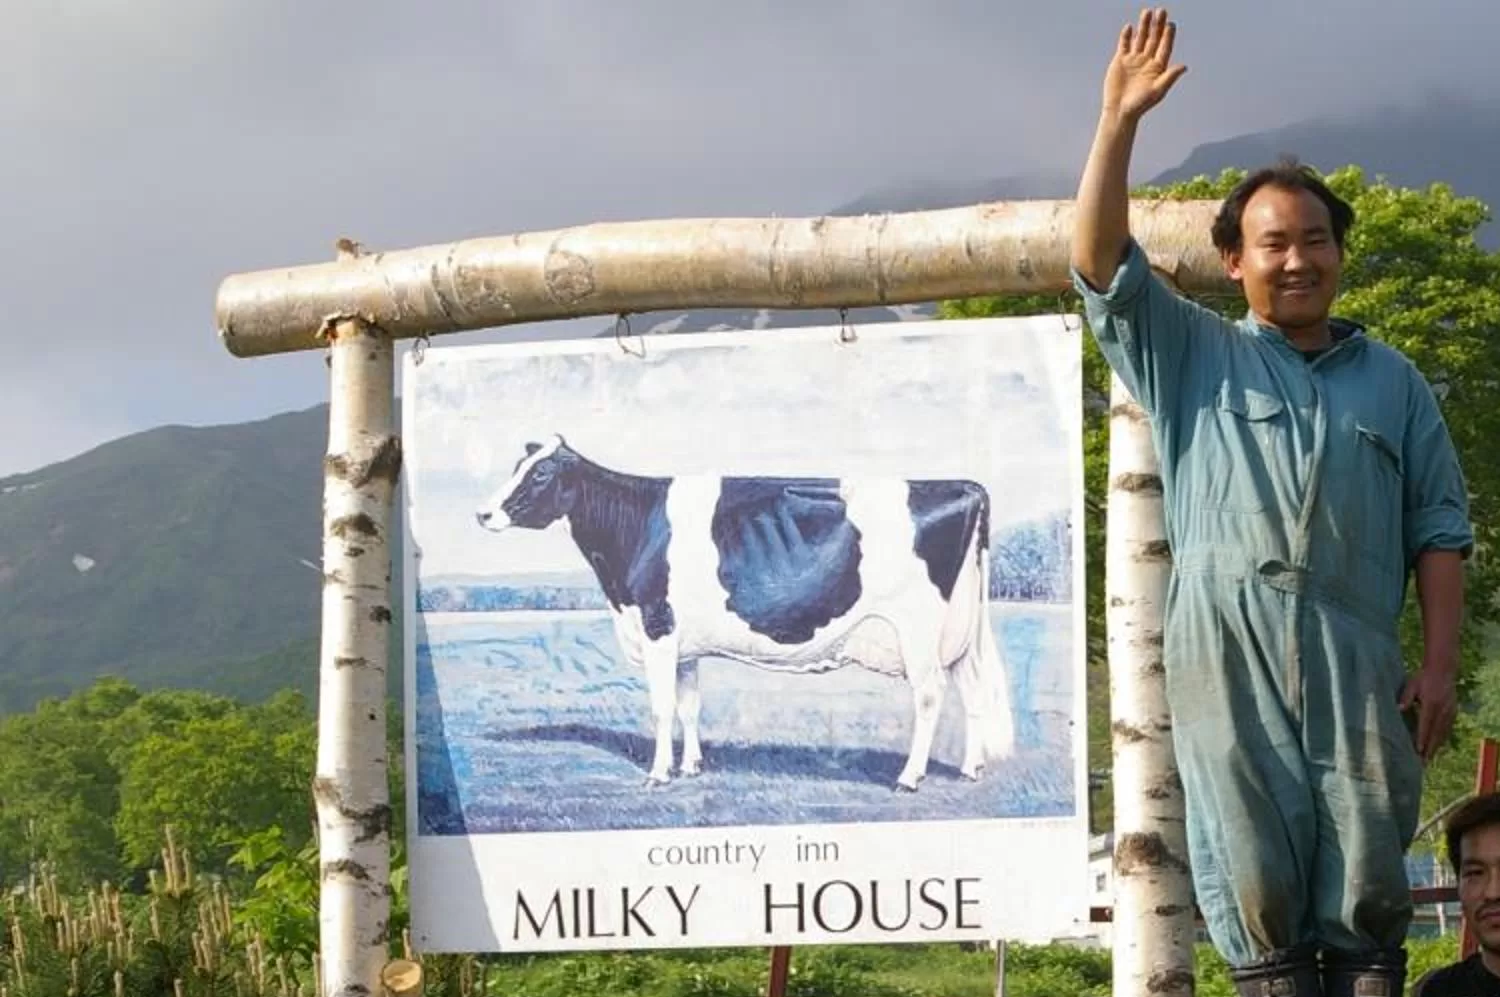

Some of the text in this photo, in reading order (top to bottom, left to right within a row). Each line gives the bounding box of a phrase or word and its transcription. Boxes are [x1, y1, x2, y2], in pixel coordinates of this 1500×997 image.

[648, 835, 839, 873] country inn
[513, 877, 982, 940] MILKY HOUSE
